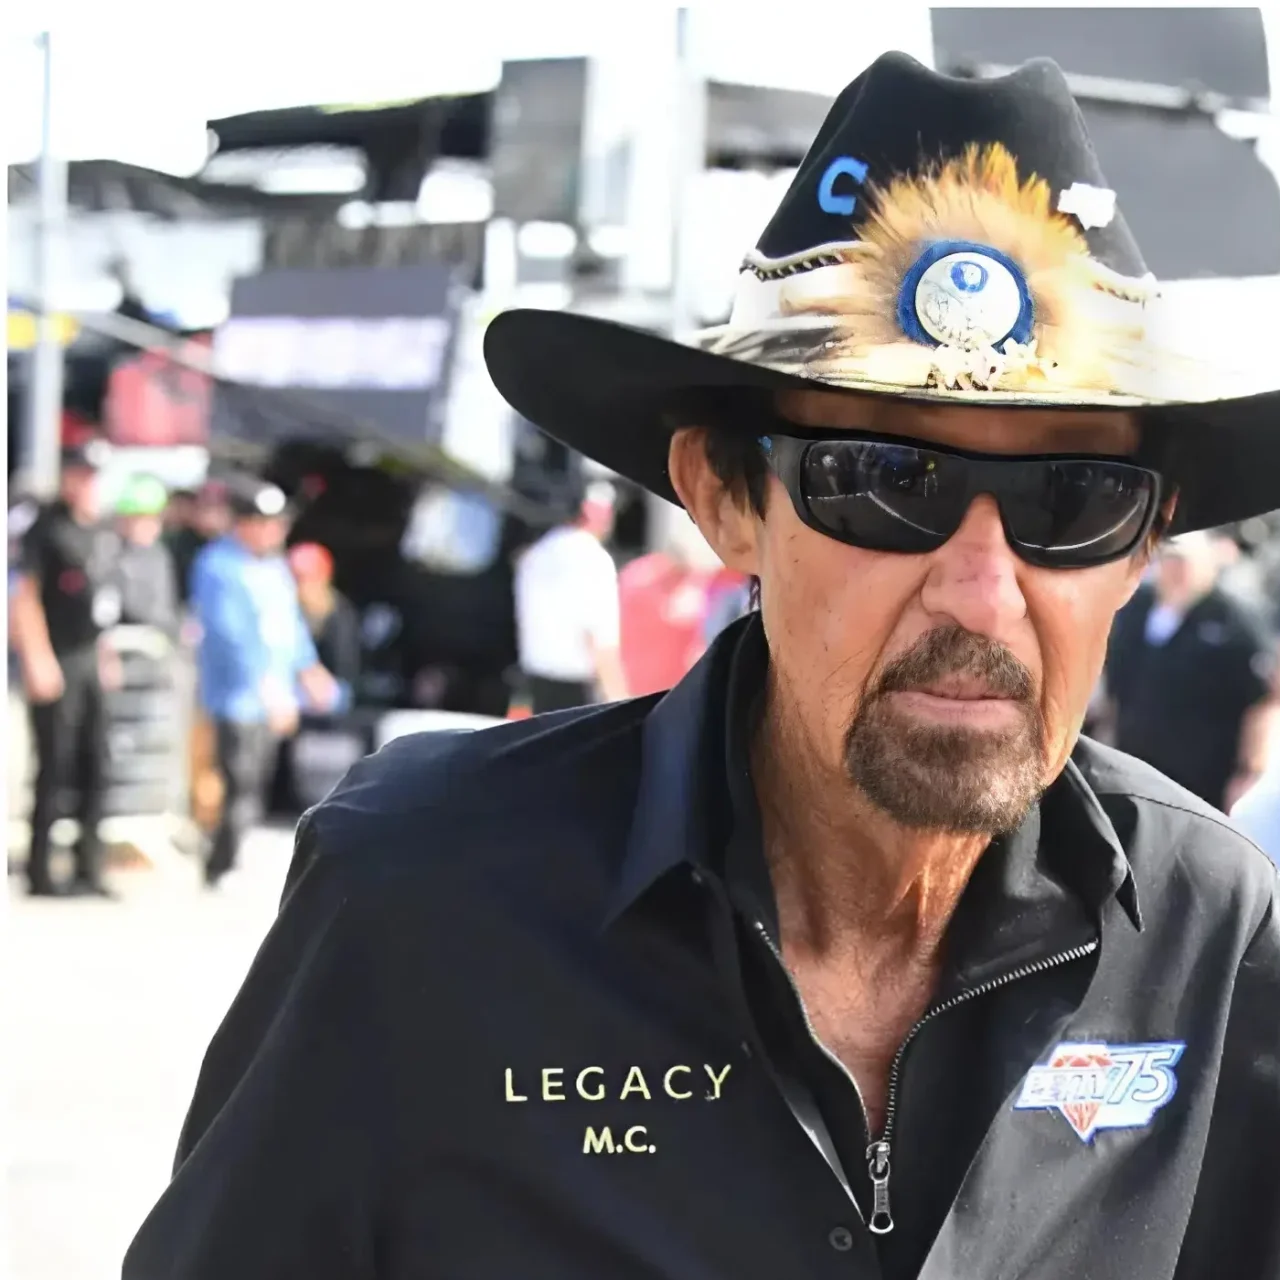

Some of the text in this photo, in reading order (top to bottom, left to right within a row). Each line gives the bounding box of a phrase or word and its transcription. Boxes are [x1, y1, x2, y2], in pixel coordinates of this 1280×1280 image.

[505, 1064, 731, 1102] LEGACY
[1106, 1049, 1176, 1105] 75
[583, 1125, 656, 1154] M.C.
